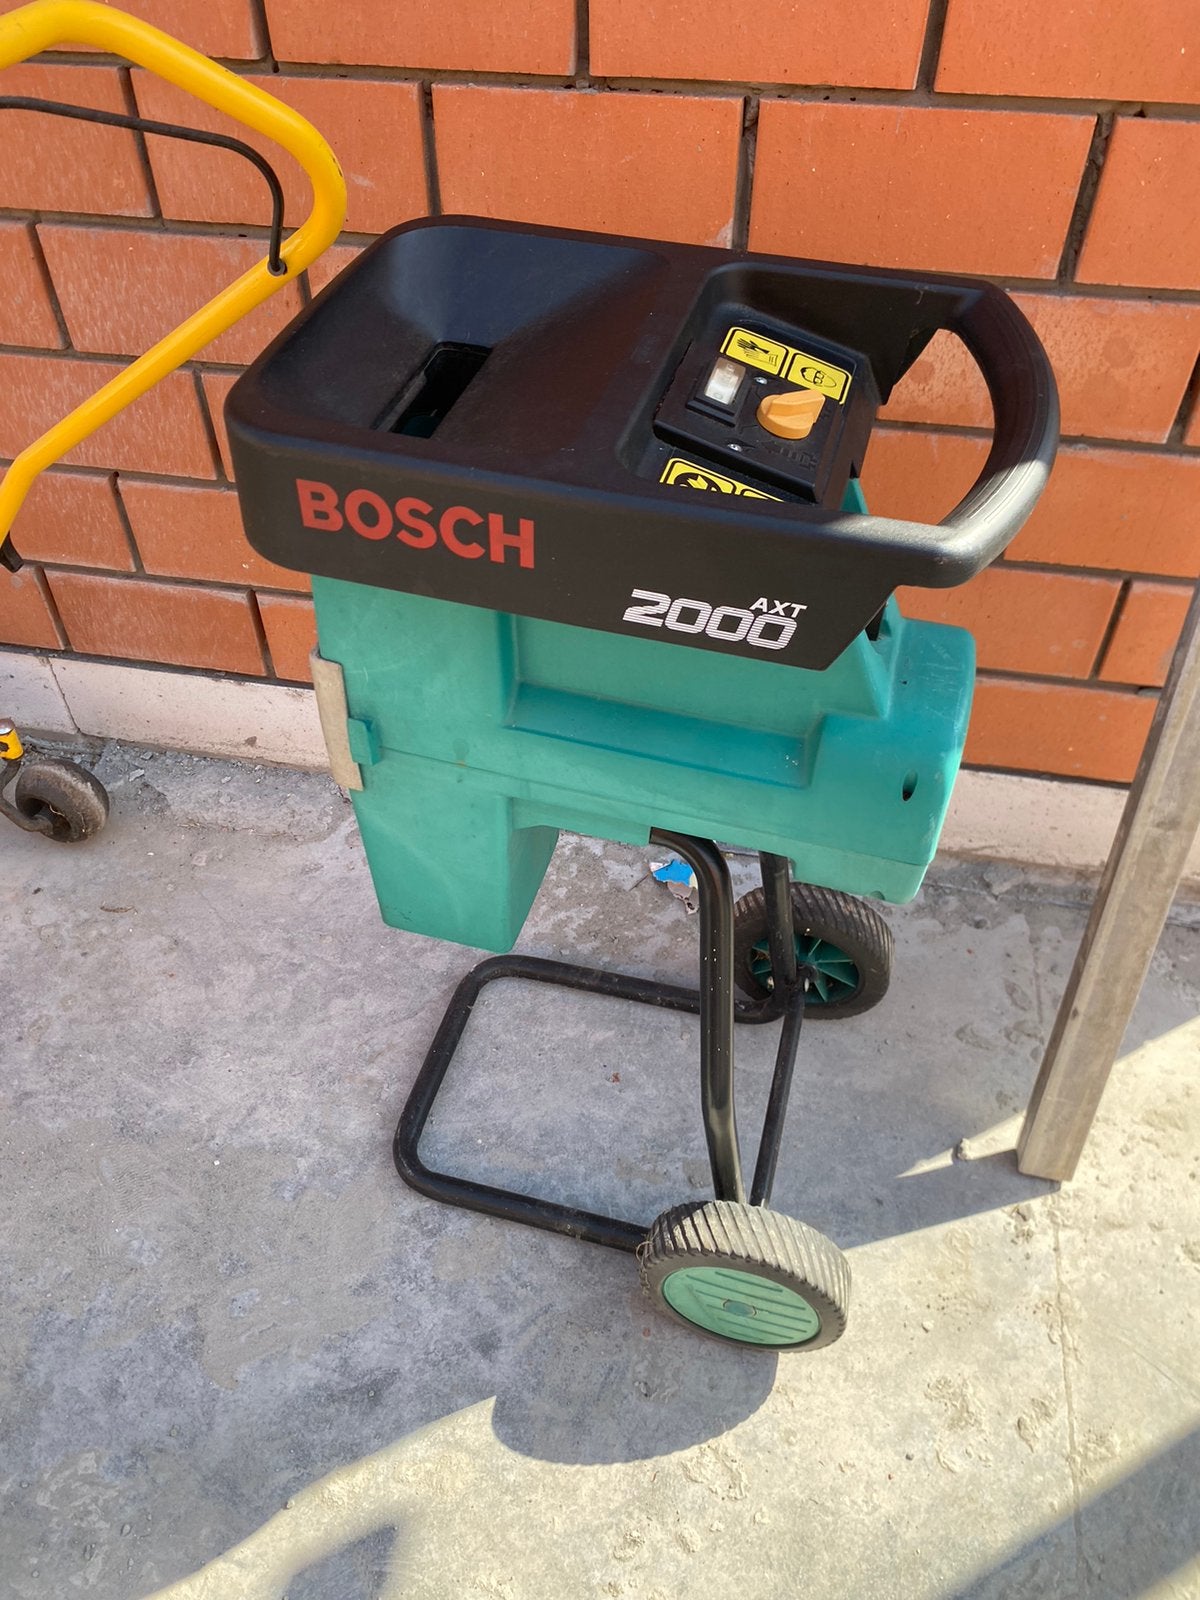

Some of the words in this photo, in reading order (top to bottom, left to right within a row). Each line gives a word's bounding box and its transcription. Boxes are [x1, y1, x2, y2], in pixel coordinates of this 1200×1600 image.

[296, 478, 535, 569] BOSCH
[622, 588, 798, 650] 2000
[749, 597, 808, 619] AXT
